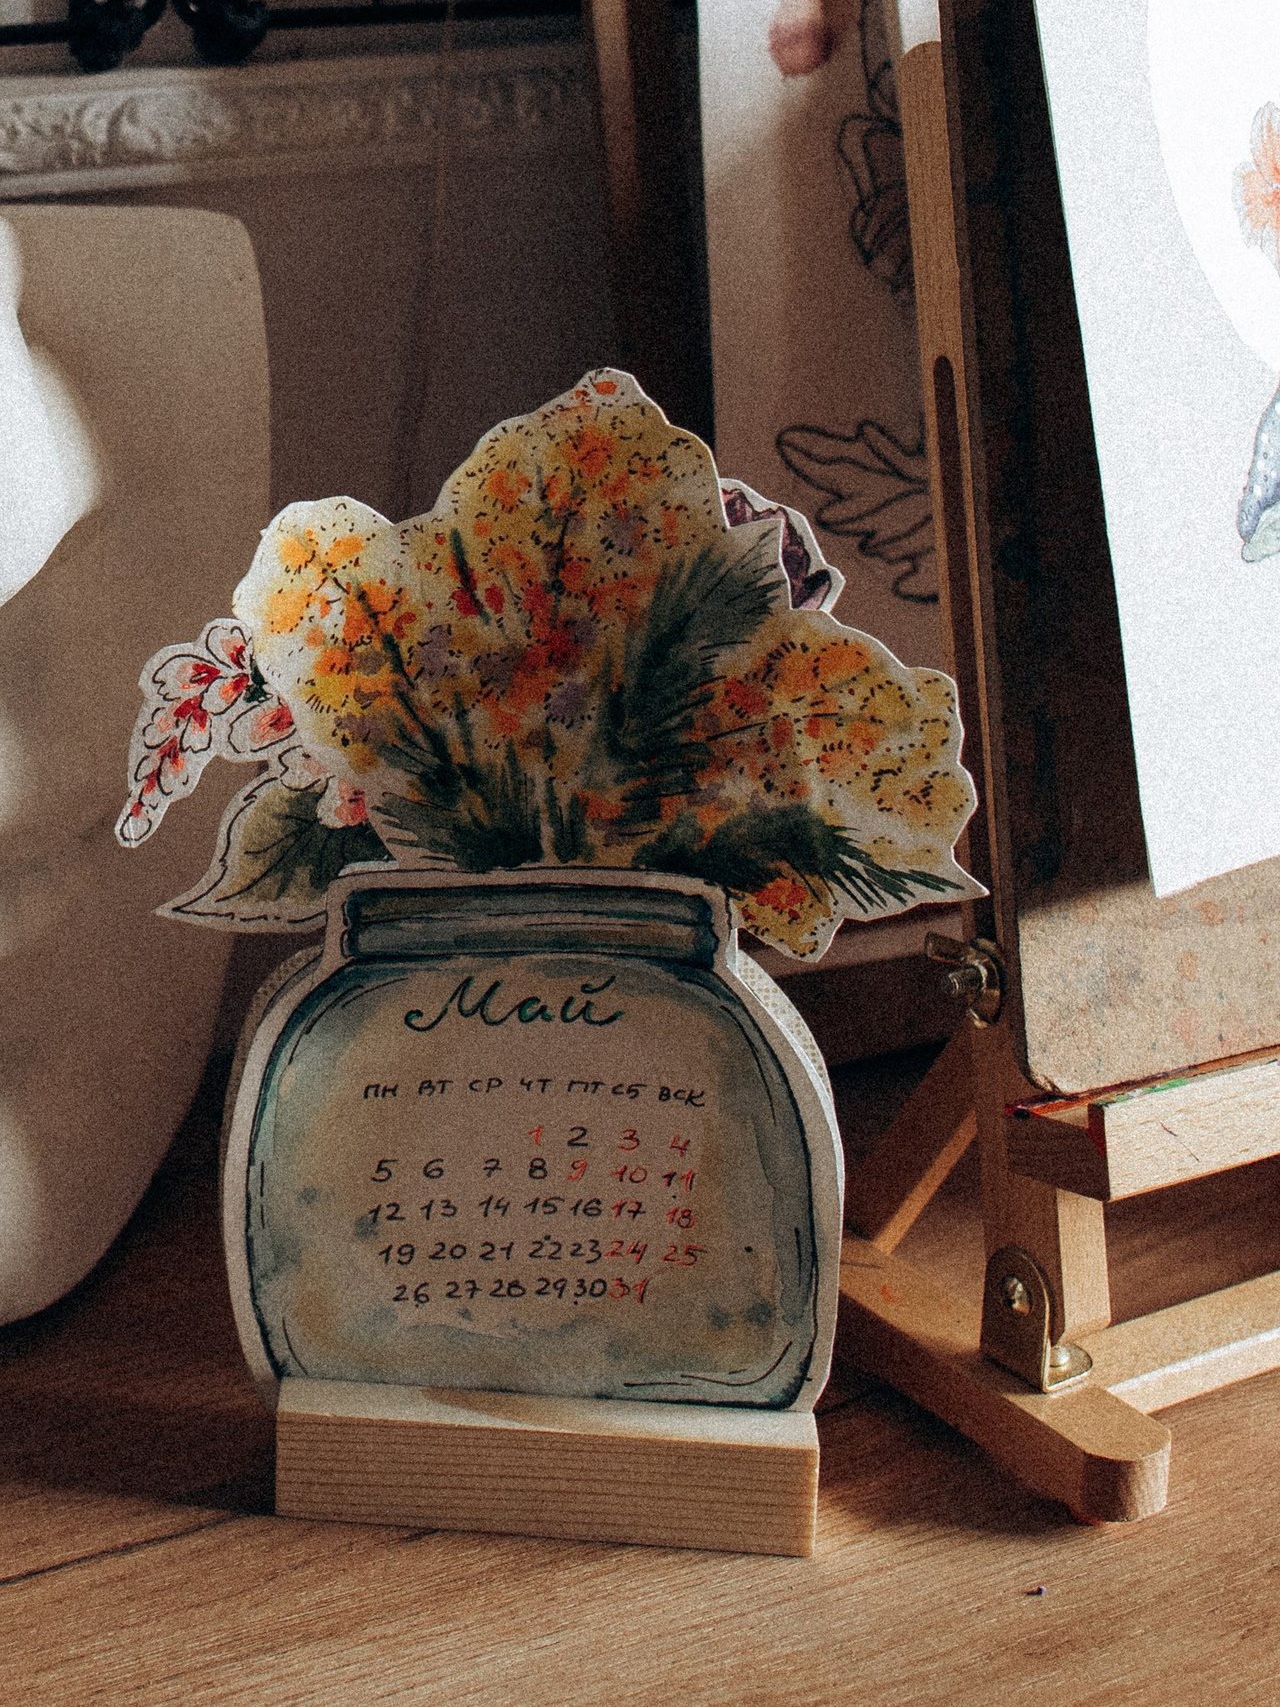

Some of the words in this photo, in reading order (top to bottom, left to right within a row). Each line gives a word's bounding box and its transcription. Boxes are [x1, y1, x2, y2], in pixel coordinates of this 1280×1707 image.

[403, 975, 627, 1033] Май
[528, 1125, 544, 1146] 1
[567, 1125, 589, 1147] 2
[617, 1128, 641, 1152] 3
[669, 1134, 691, 1158] 4
[371, 1157, 399, 1183] 5
[422, 1157, 445, 1180] 6
[482, 1157, 503, 1178] 7
[528, 1157, 549, 1181] 8
[567, 1158, 588, 1182] 9
[611, 1164, 648, 1184] 10
[662, 1168, 696, 1193] 11
[368, 1202, 406, 1224] 12
[420, 1199, 458, 1221] 13
[478, 1195, 511, 1218] 14
[523, 1196, 565, 1215] 15
[571, 1198, 603, 1218] 16
[610, 1200, 646, 1221] 17
[666, 1206, 696, 1230] 18
[378, 1243, 416, 1266] 19
[427, 1242, 467, 1260] 20
[479, 1241, 515, 1261] 21
[528, 1240, 562, 1260] 22
[570, 1239, 602, 1264] 23
[604, 1240, 649, 1265] 24
[661, 1244, 708, 1267] 25
[392, 1282, 430, 1304] 26
[445, 1279, 483, 1299] 27
[489, 1278, 527, 1298] 28
[535, 1276, 568, 1299] 29
[573, 1278, 608, 1298] 30
[608, 1277, 650, 1304] 31
